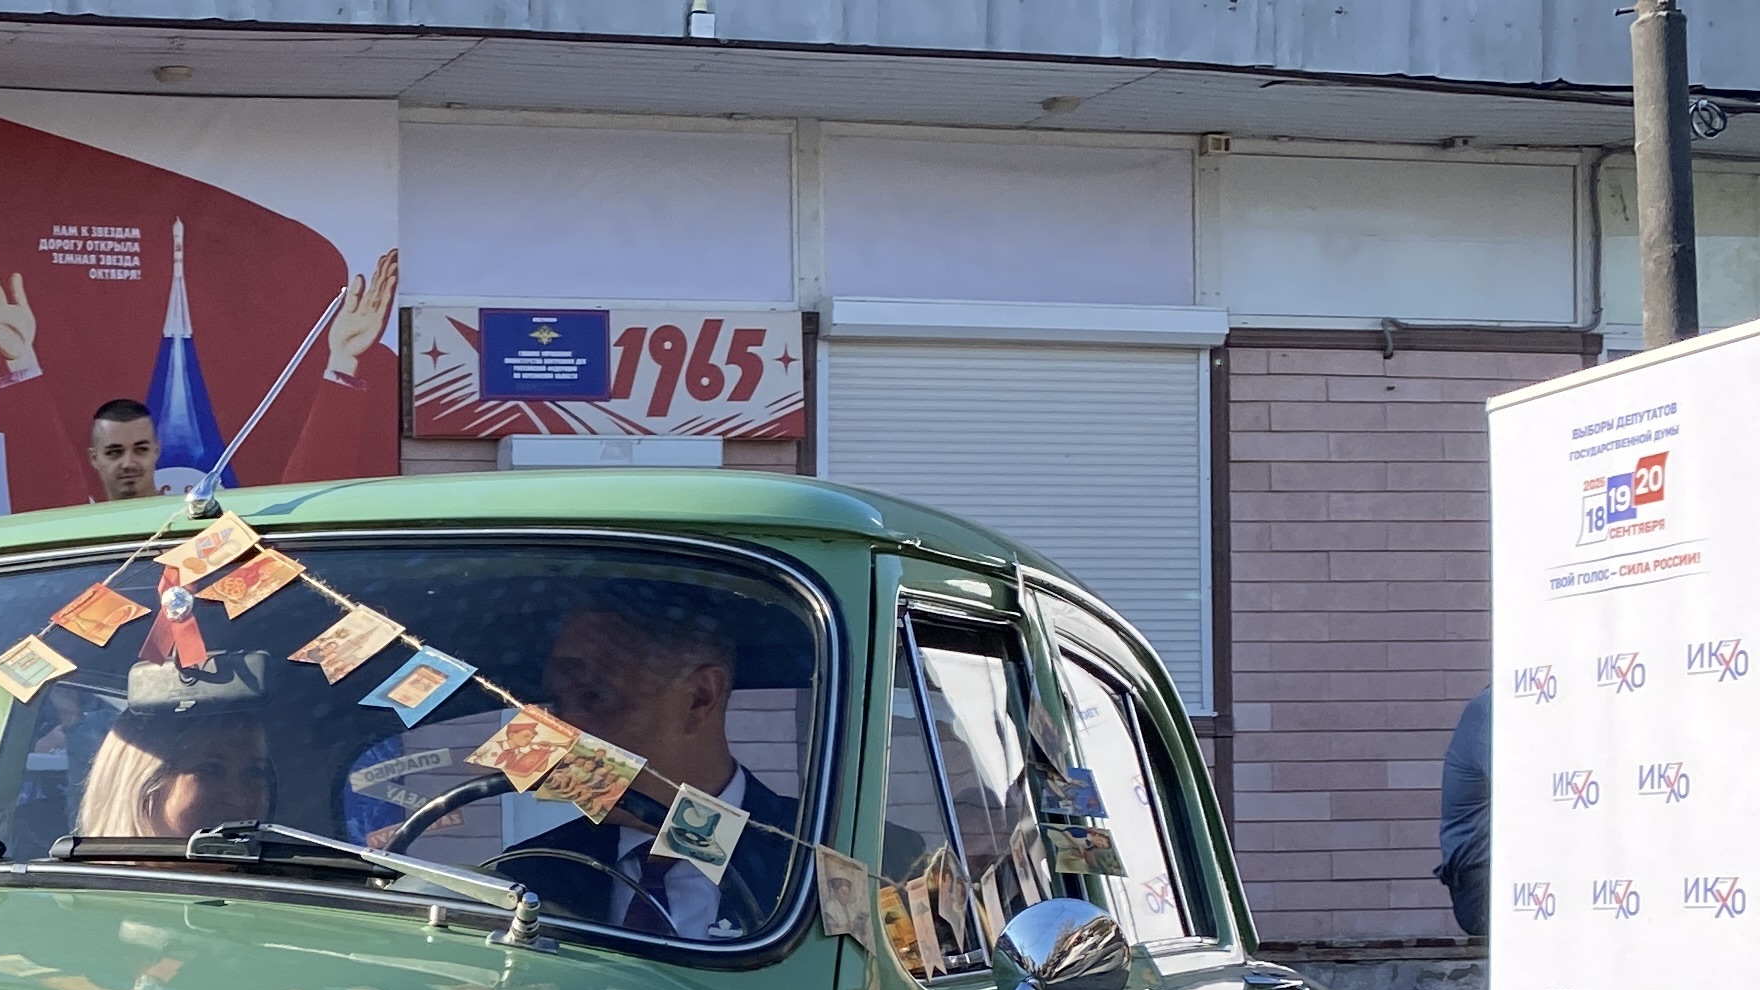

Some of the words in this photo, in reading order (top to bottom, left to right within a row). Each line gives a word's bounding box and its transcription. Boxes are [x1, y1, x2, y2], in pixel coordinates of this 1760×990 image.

[38, 238, 83, 251] ДОРОГУ
[86, 240, 140, 252] ОТКРЫЛА
[53, 225, 78, 236] НАМ
[81, 226, 89, 237] К
[91, 226, 141, 239] ЗВЕЗДАМ
[52, 252, 97, 264] ЗЕМНАЯ
[99, 254, 140, 267] ЗВЕЗДА
[89, 268, 142, 280] ОКТЯБРЯ!
[611, 318, 767, 417] 1965
[1572, 418, 1614, 440] ВЫБОРЫ
[1616, 402, 1677, 430] ДЕПУТАТОВ
[1569, 429, 1652, 461] ГОСУДАРСТВЕННОЙ
[1654, 424, 1679, 443] ДУМЫ
[1586, 506, 1605, 533] 18
[1609, 484, 1631, 514] 19
[1635, 464, 1663, 495] 20
[1610, 518, 1666, 540] СЕНТЯБРЯ
[1550, 572, 1575, 590] ТВОЙ
[1578, 569, 1610, 586] ГОЛОС
[1619, 561, 1651, 577] СИЛА
[1653, 551, 1701, 572] РОССИИ!
